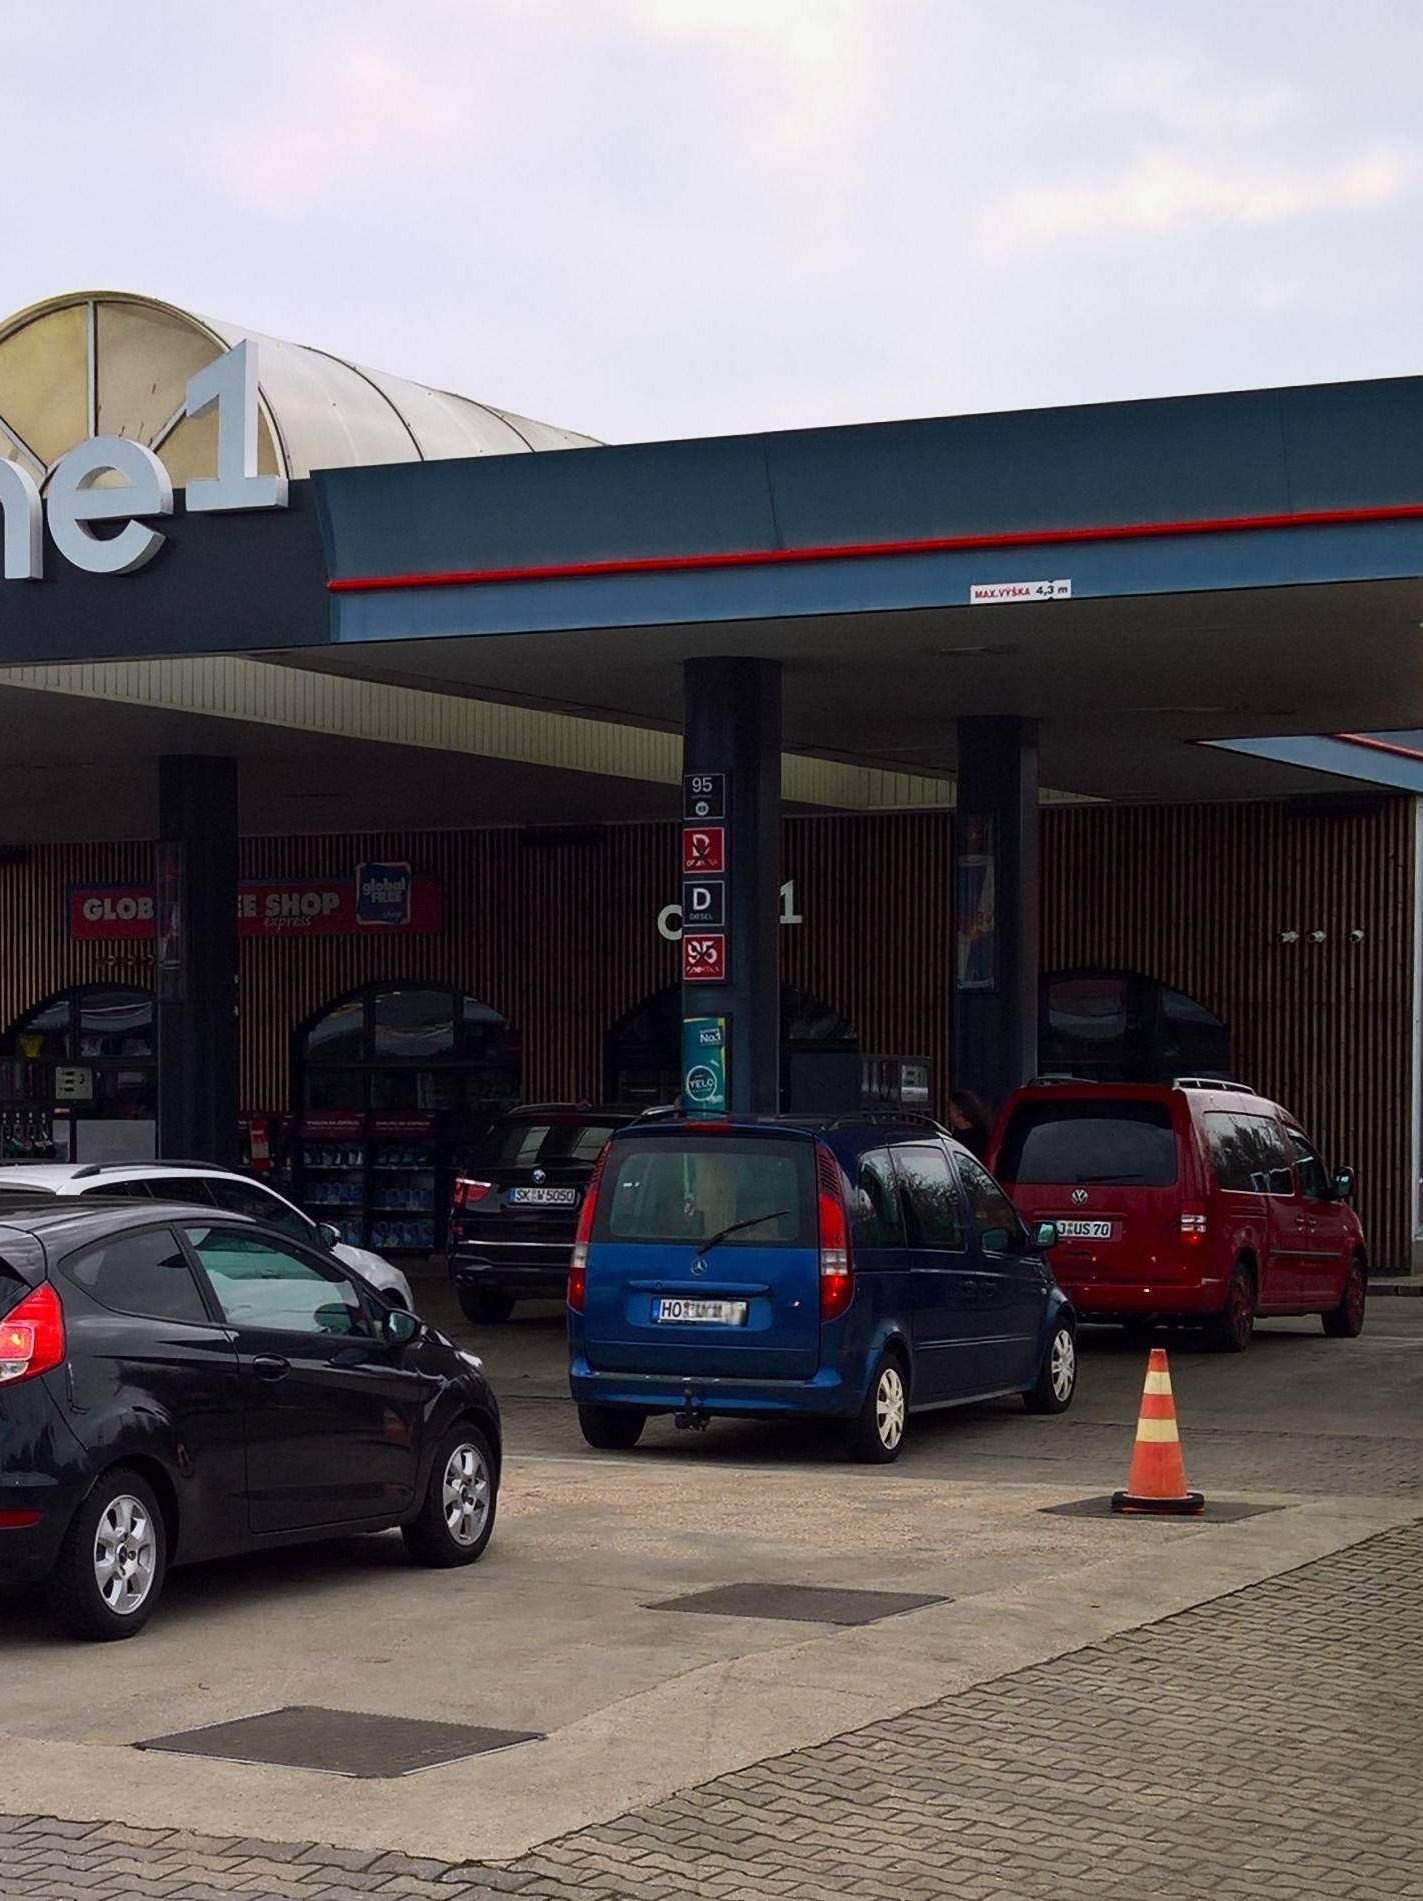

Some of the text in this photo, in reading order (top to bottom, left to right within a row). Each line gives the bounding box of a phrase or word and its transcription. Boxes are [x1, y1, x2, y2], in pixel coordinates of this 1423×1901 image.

[1036, 585, 1054, 596] 4,3
[1057, 586, 1068, 594] m
[691, 776, 713, 793] 95
[692, 887, 712, 911] D
[82, 897, 155, 921] GLOB
[264, 892, 341, 917] SHOP
[264, 915, 314, 931] express
[700, 1032, 722, 1043] No.1
[689, 1079, 715, 1089] VELO
[1093, 1223, 1110, 1236] 70
